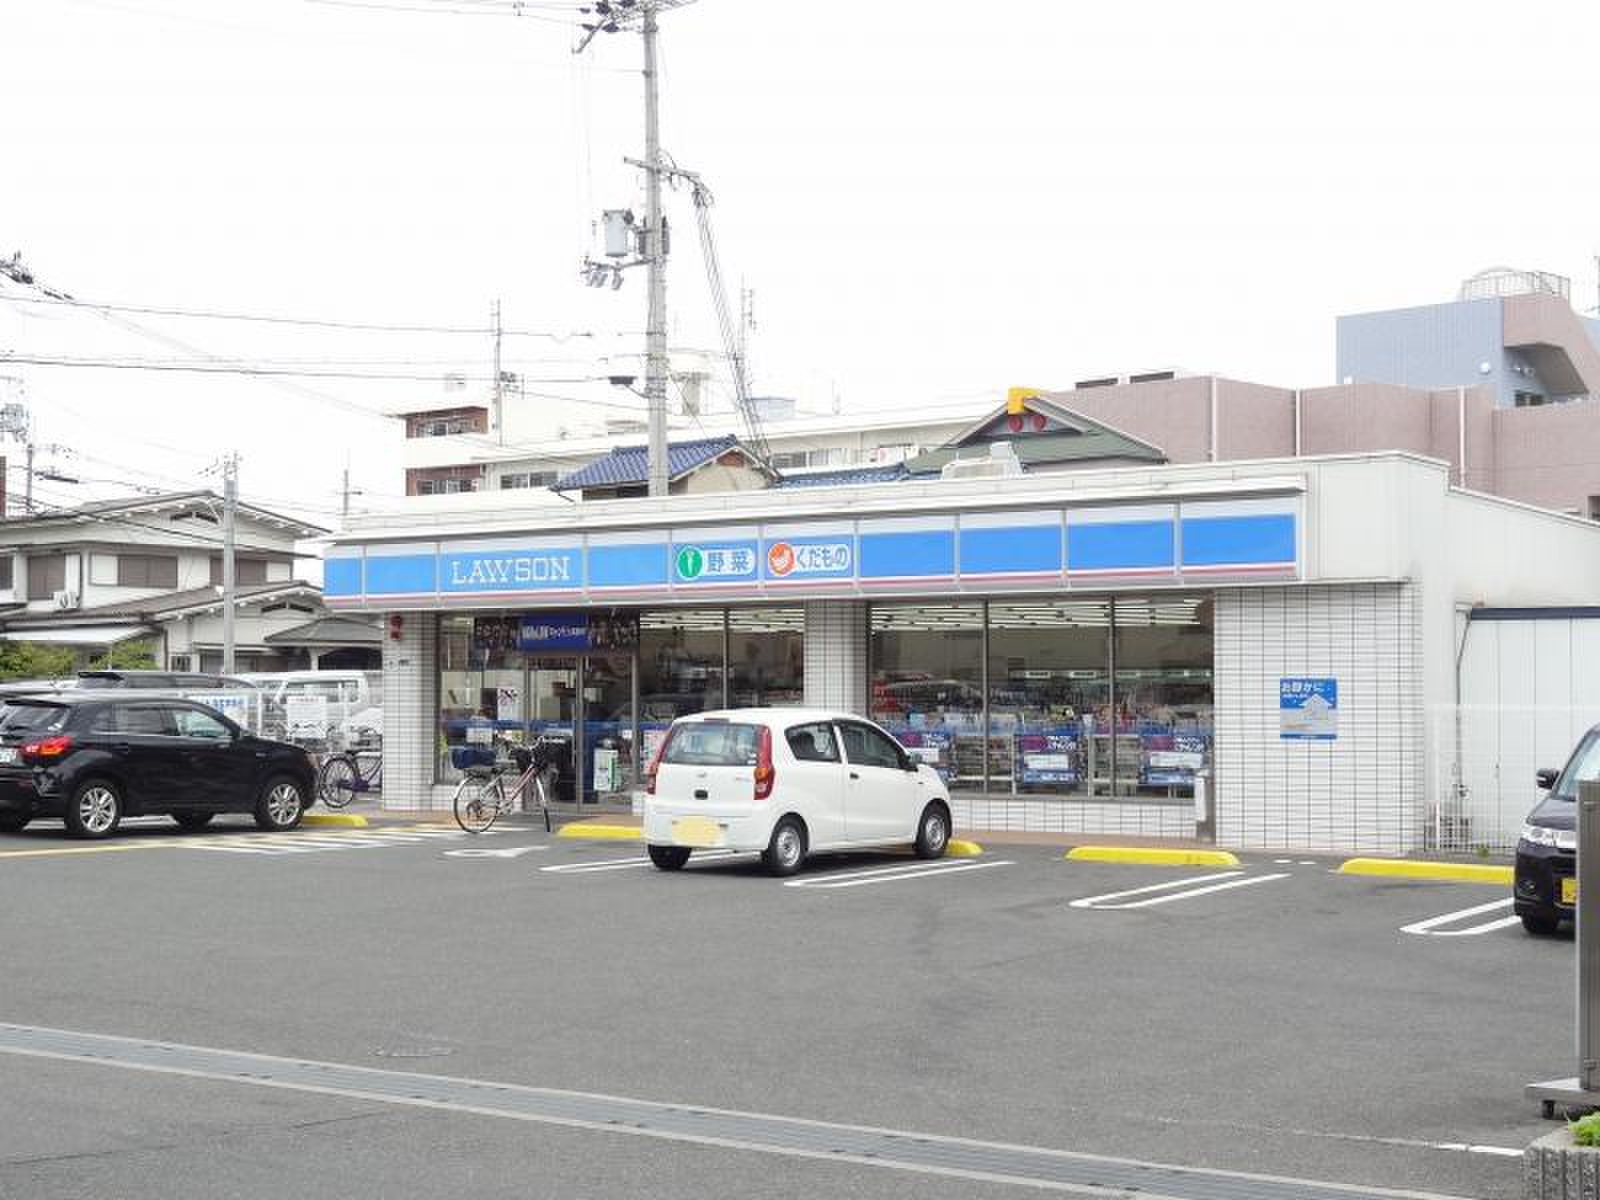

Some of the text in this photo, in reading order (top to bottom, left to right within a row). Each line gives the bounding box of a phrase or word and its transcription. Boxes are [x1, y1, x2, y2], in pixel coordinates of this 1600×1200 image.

[707, 551, 750, 573] 野菜
[797, 547, 848, 569] くだもの
[451, 556, 571, 585] LAWSON
